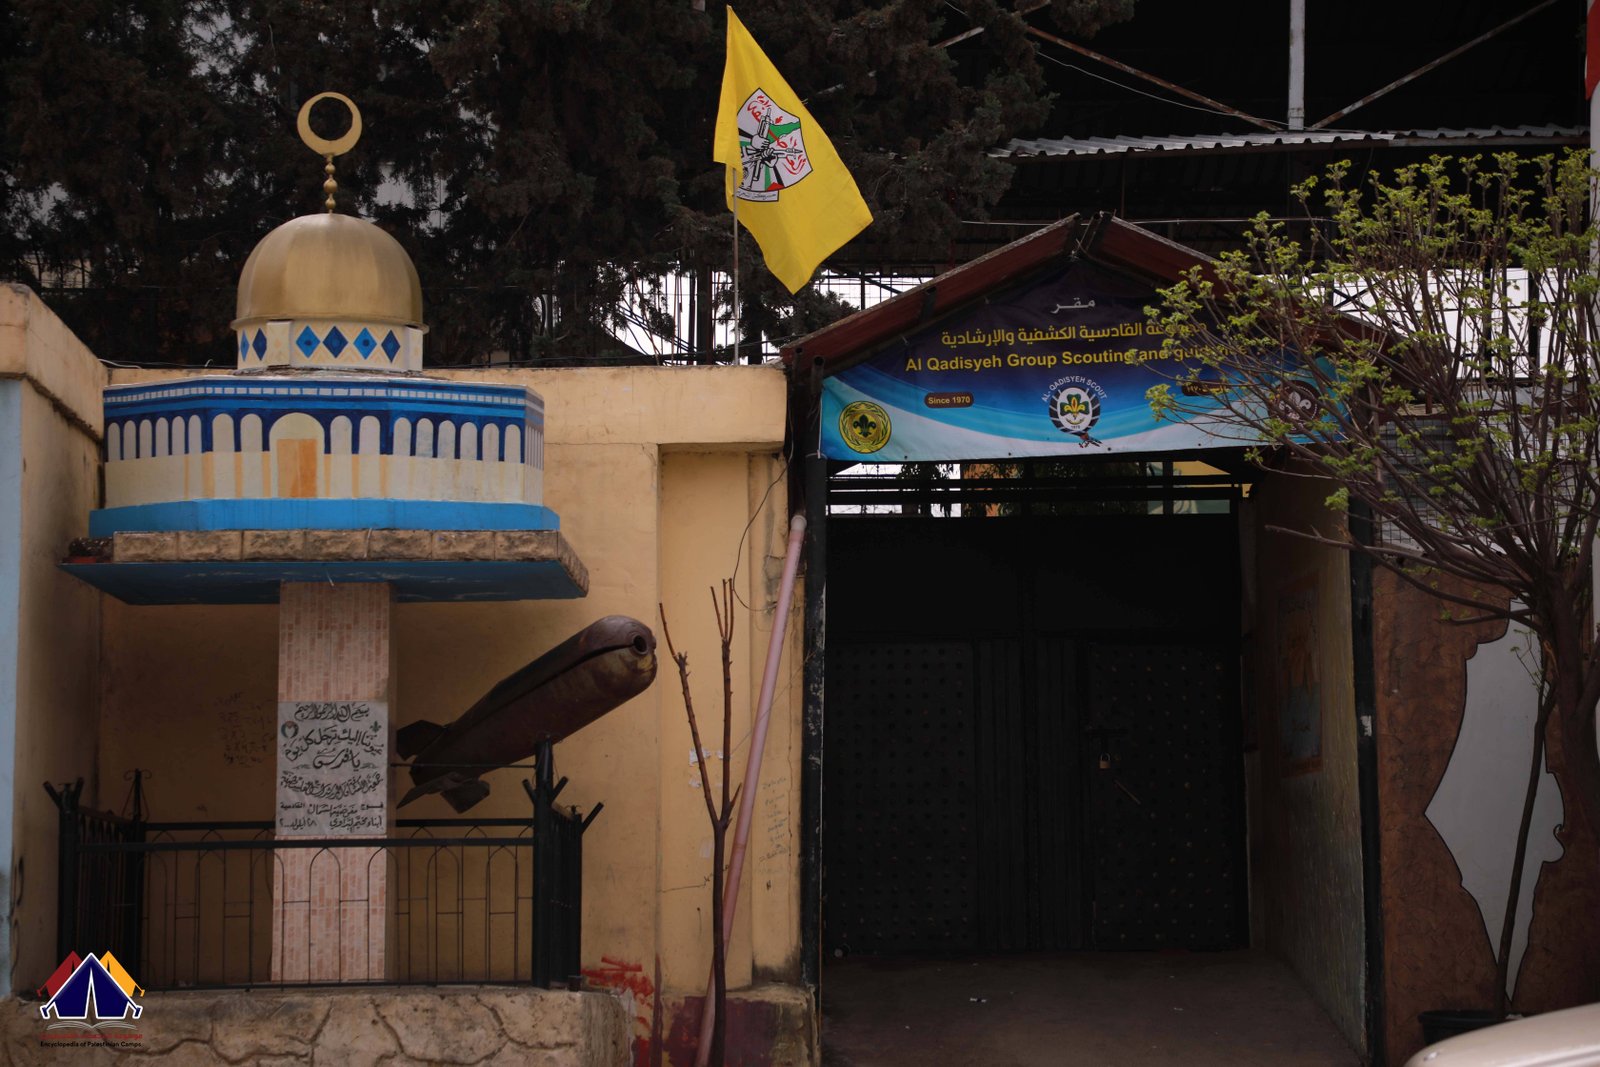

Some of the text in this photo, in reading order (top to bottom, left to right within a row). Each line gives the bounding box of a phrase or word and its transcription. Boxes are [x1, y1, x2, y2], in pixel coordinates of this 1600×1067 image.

[1051, 297, 1096, 314] مقر
[941, 329, 1015, 348] والإرشادية
[1018, 326, 1076, 345] الكشفية
[1079, 322, 1142, 342] القادسية
[905, 358, 922, 371] Al
[927, 354, 1002, 373] Qadisyeh
[1007, 352, 1057, 369] Group
[1062, 348, 1137, 365] Scouting
[1139, 345, 1169, 360] and
[1049, 375, 1086, 391] QADISYEH
[1086, 379, 1108, 400] SCOUT
[928, 395, 971, 405] Since 1970
[337, 703, 351, 722] الله
[351, 703, 370, 721] بسم
